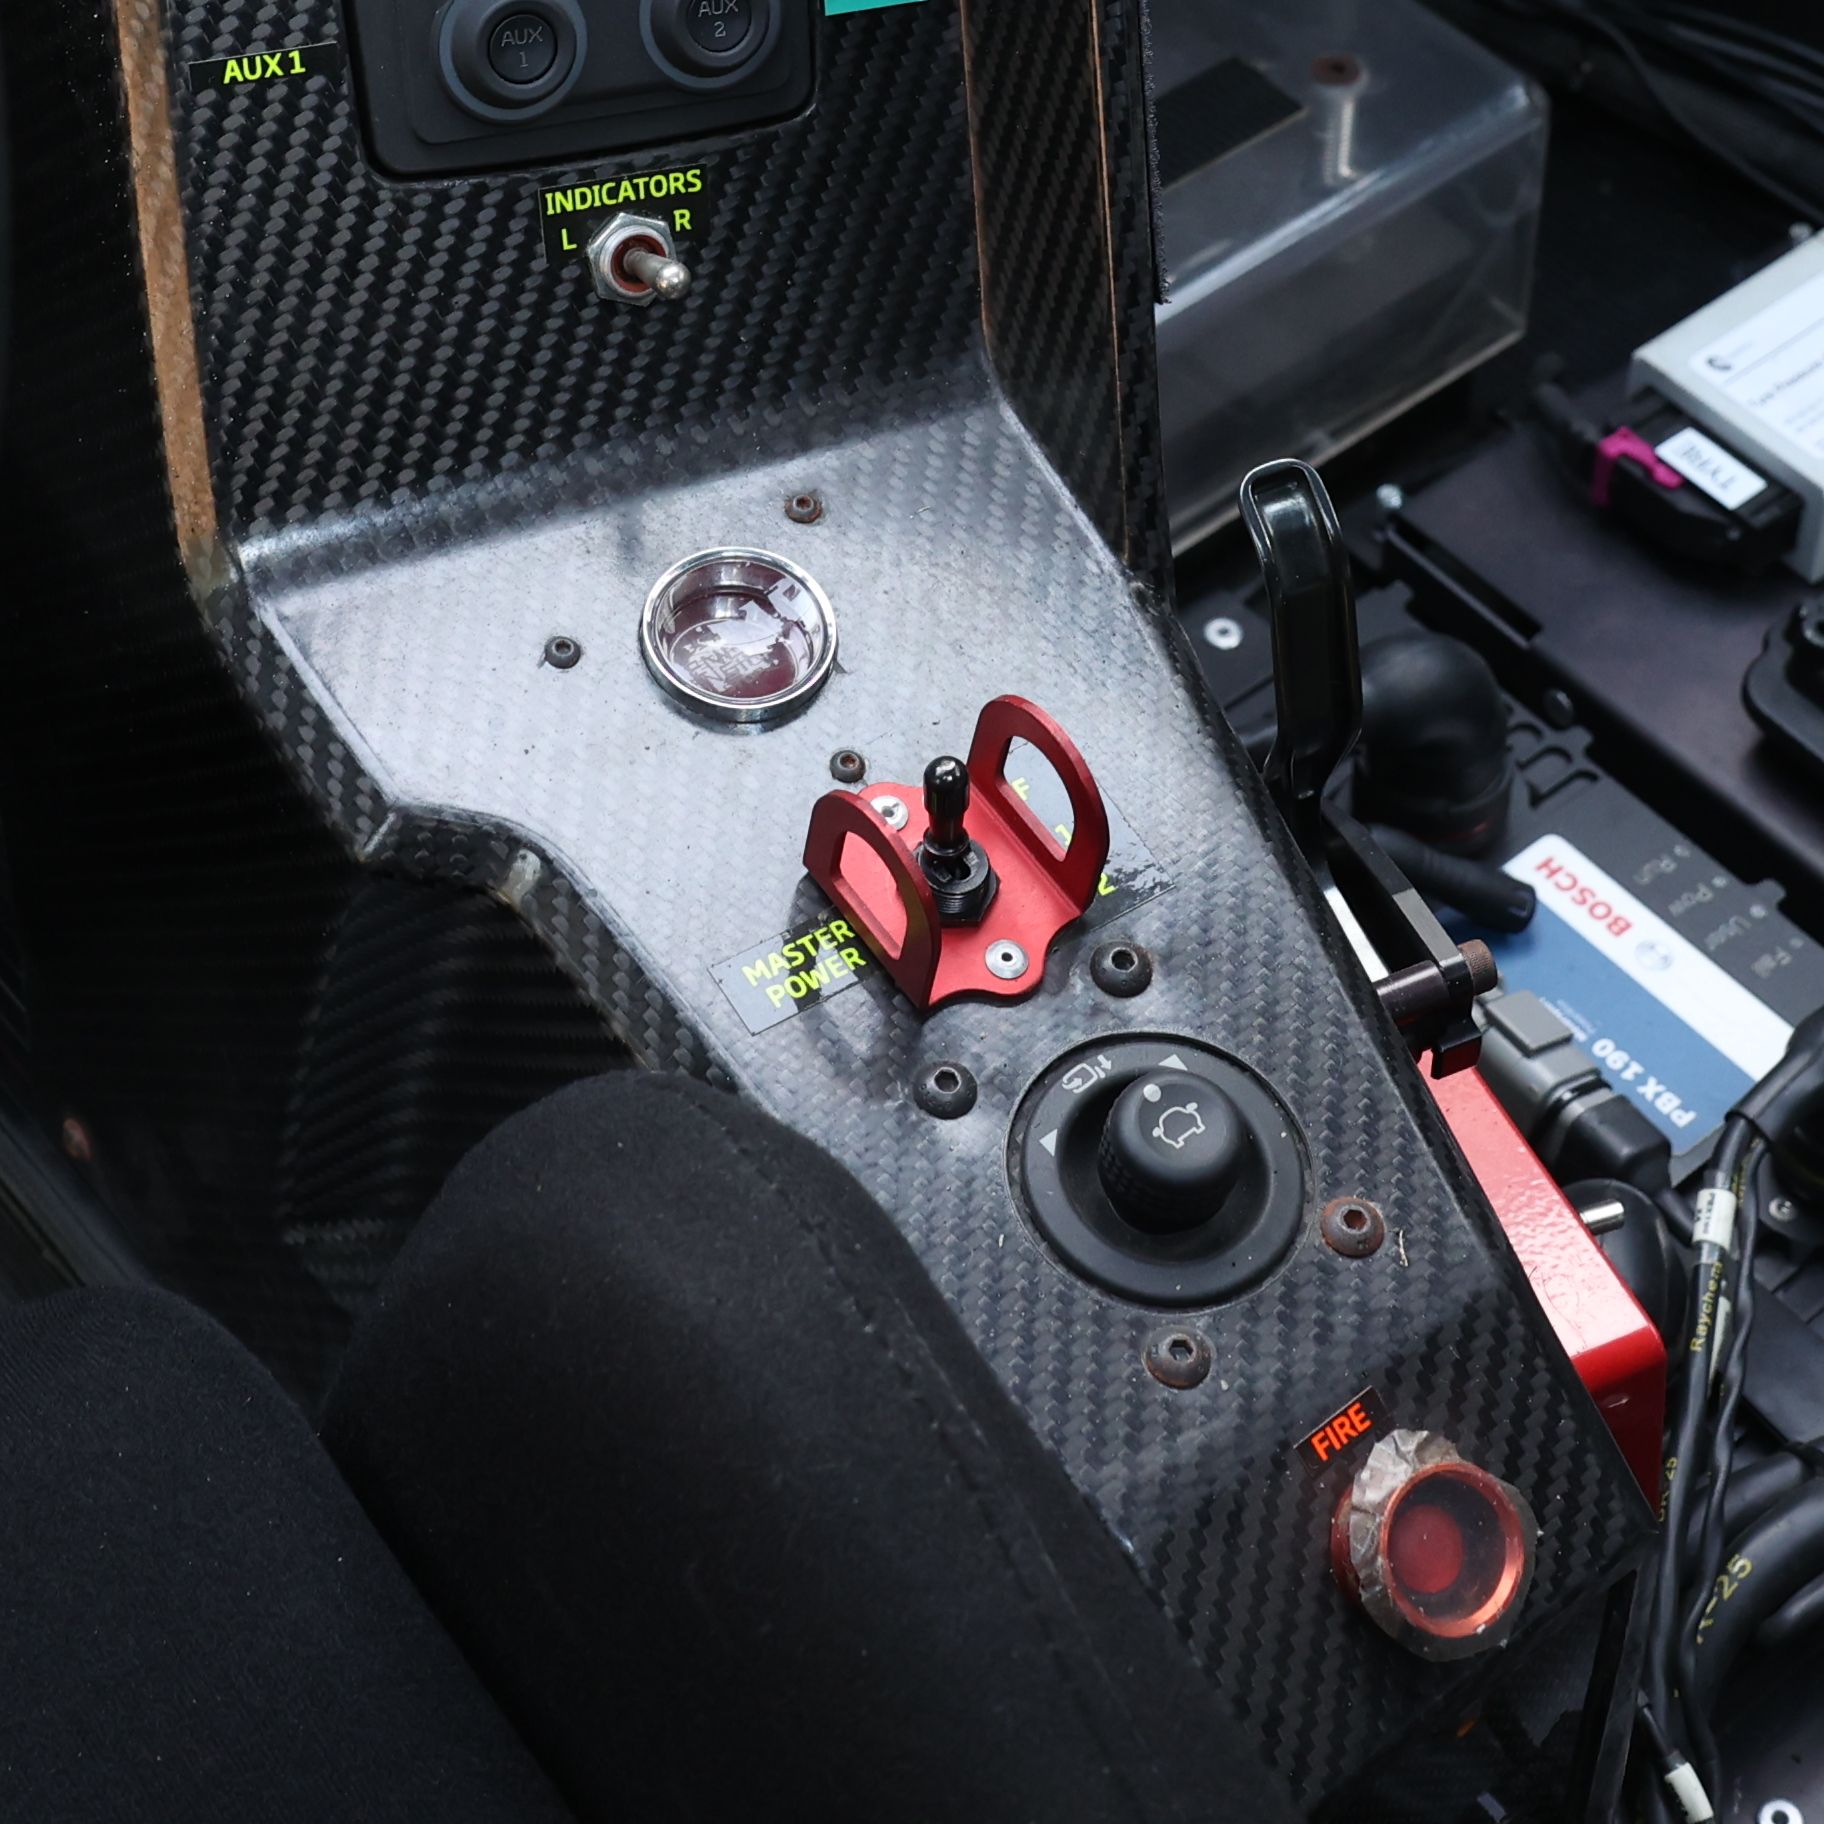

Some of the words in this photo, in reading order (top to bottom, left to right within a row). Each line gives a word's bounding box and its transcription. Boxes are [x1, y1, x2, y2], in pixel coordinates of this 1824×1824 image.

[500, 27, 544, 49] AUX
[713, 20, 726, 38] 2
[223, 52, 284, 85] AUX
[287, 50, 307, 76] 1
[544, 167, 703, 215] INDICATORS
[561, 225, 577, 251] L
[673, 208, 692, 232] R
[1535, 856, 1632, 938] BOSCH
[741, 918, 857, 988] MASTER
[766, 945, 868, 1009] POWER
[1591, 1037, 1646, 1082] 190
[1636, 1076, 1697, 1129] PBX
[1689, 1261, 1724, 1353] Raychem
[1309, 1398, 1373, 1464] FIRE
